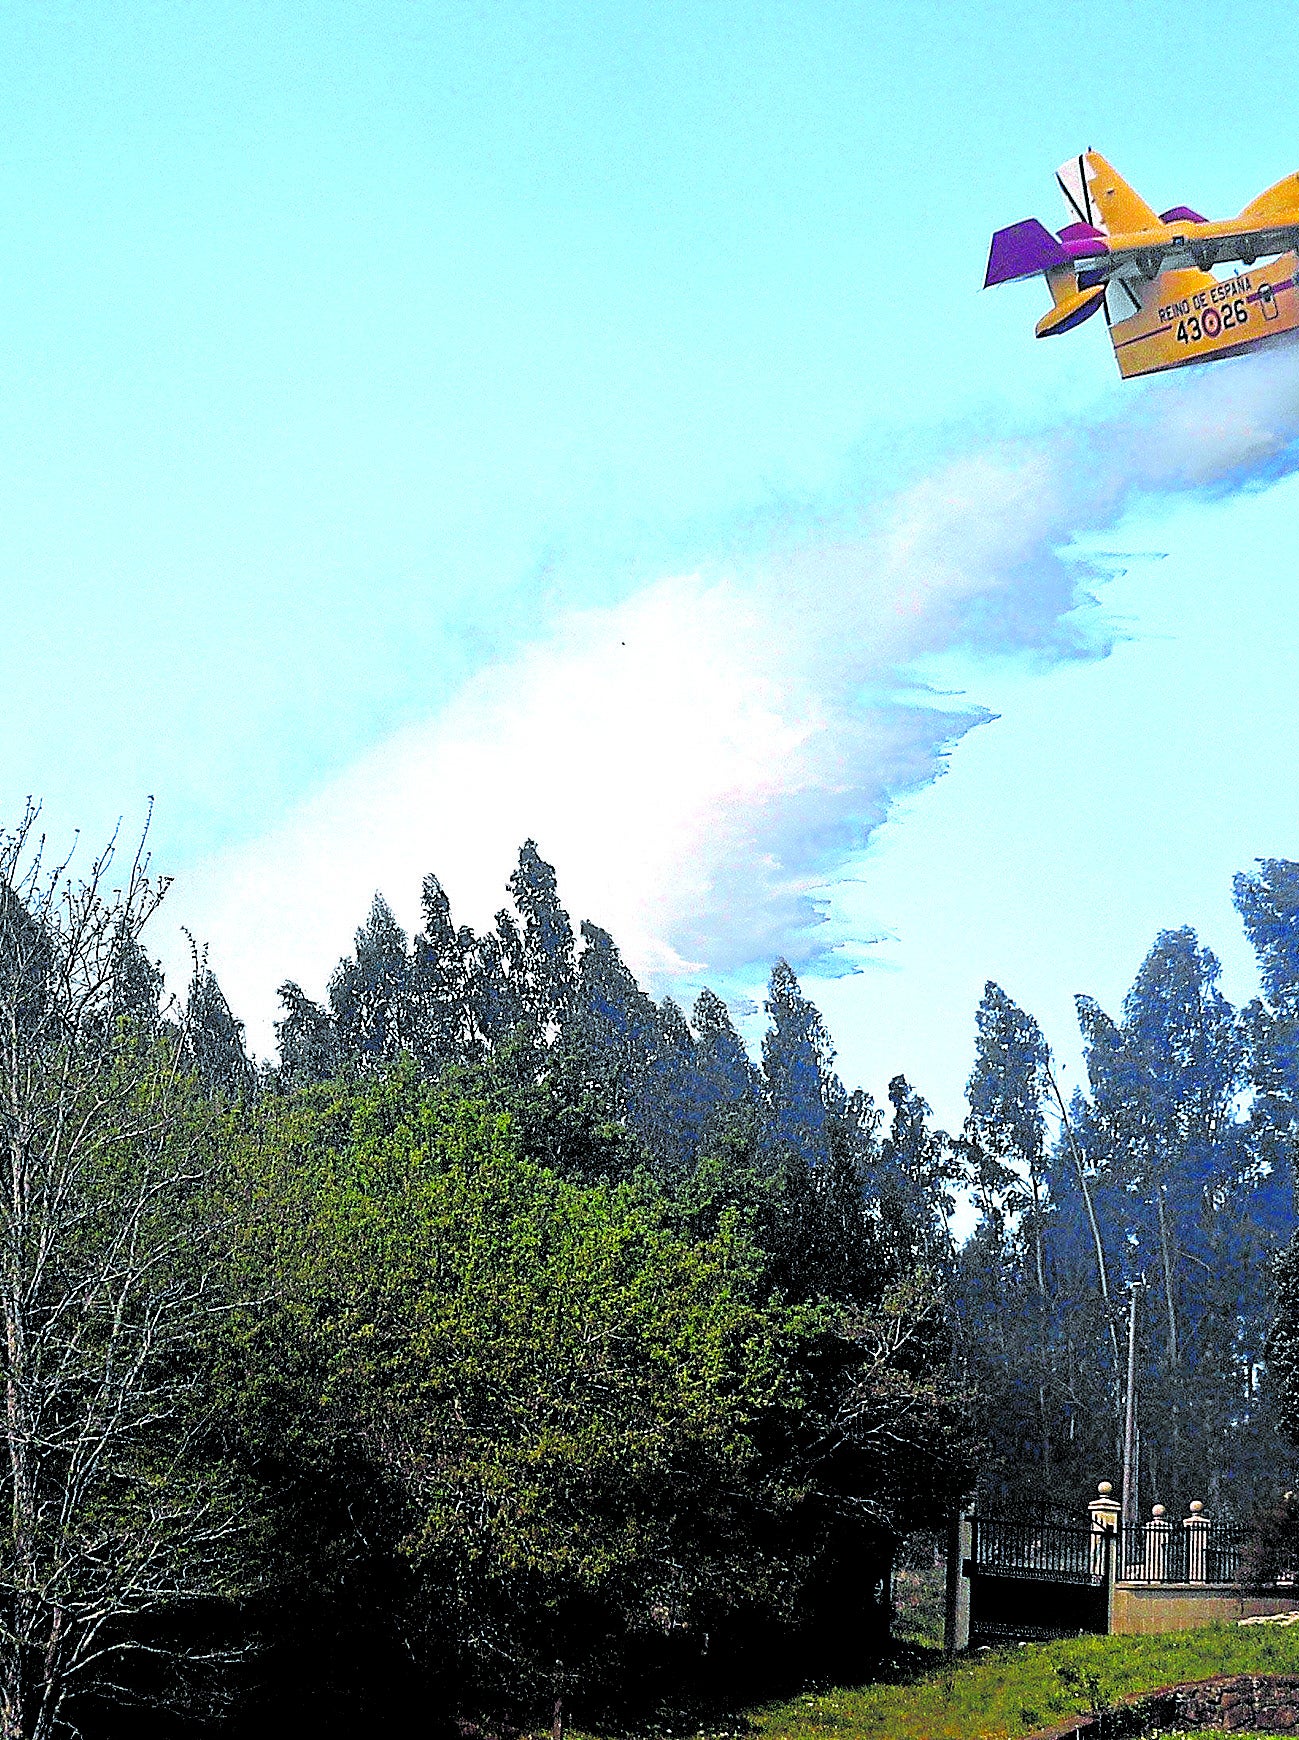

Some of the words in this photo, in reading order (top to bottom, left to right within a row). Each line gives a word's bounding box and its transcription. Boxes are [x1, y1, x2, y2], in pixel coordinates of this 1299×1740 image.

[1158, 300, 1190, 322] REINO
[1193, 292, 1208, 310] DE
[1177, 317, 1202, 344] 43
[1220, 300, 1248, 329] 26
